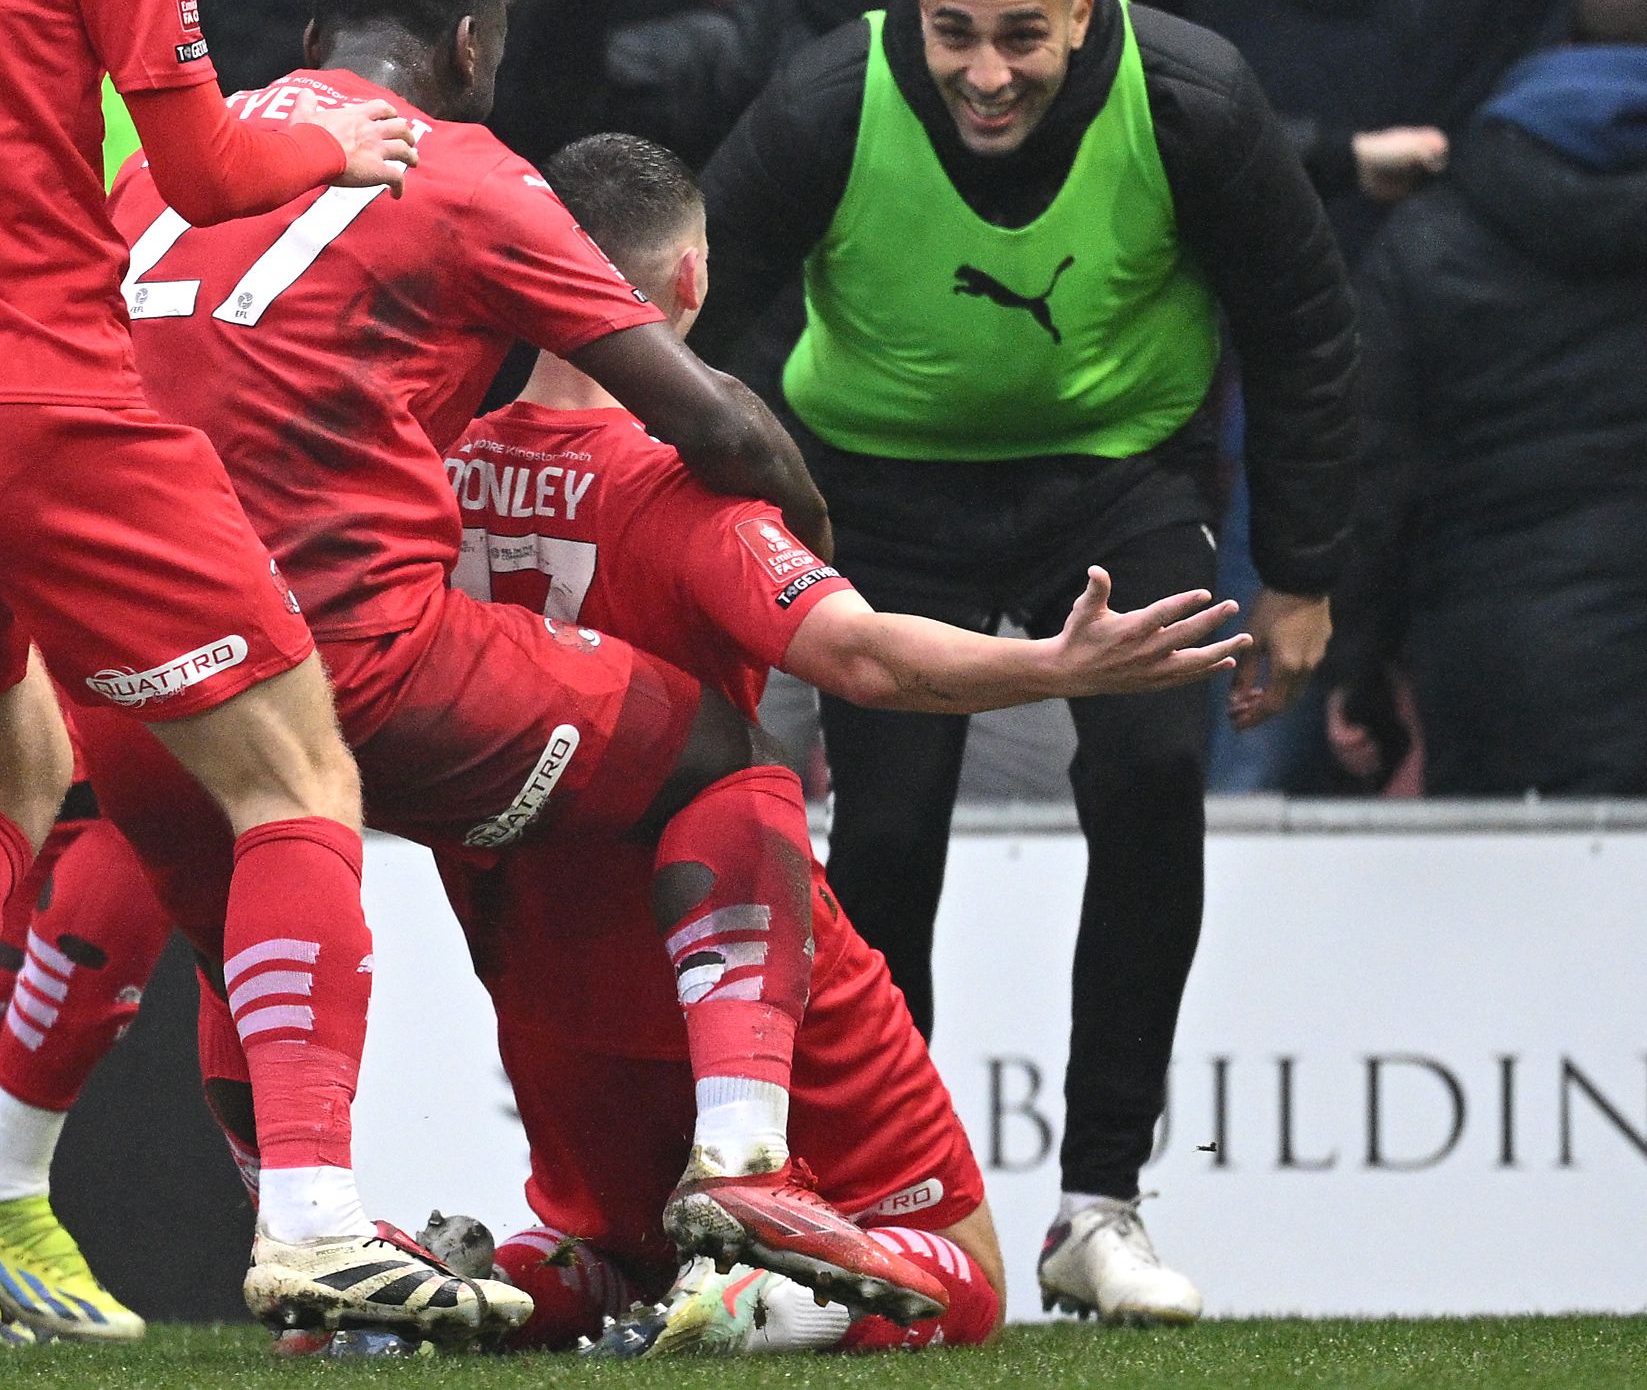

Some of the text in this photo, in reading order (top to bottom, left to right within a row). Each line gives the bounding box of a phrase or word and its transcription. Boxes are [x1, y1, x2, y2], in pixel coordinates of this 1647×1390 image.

[235, 310, 248, 319] EFL
[774, 561, 794, 576] FA
[93, 644, 234, 696] QUATTRO
